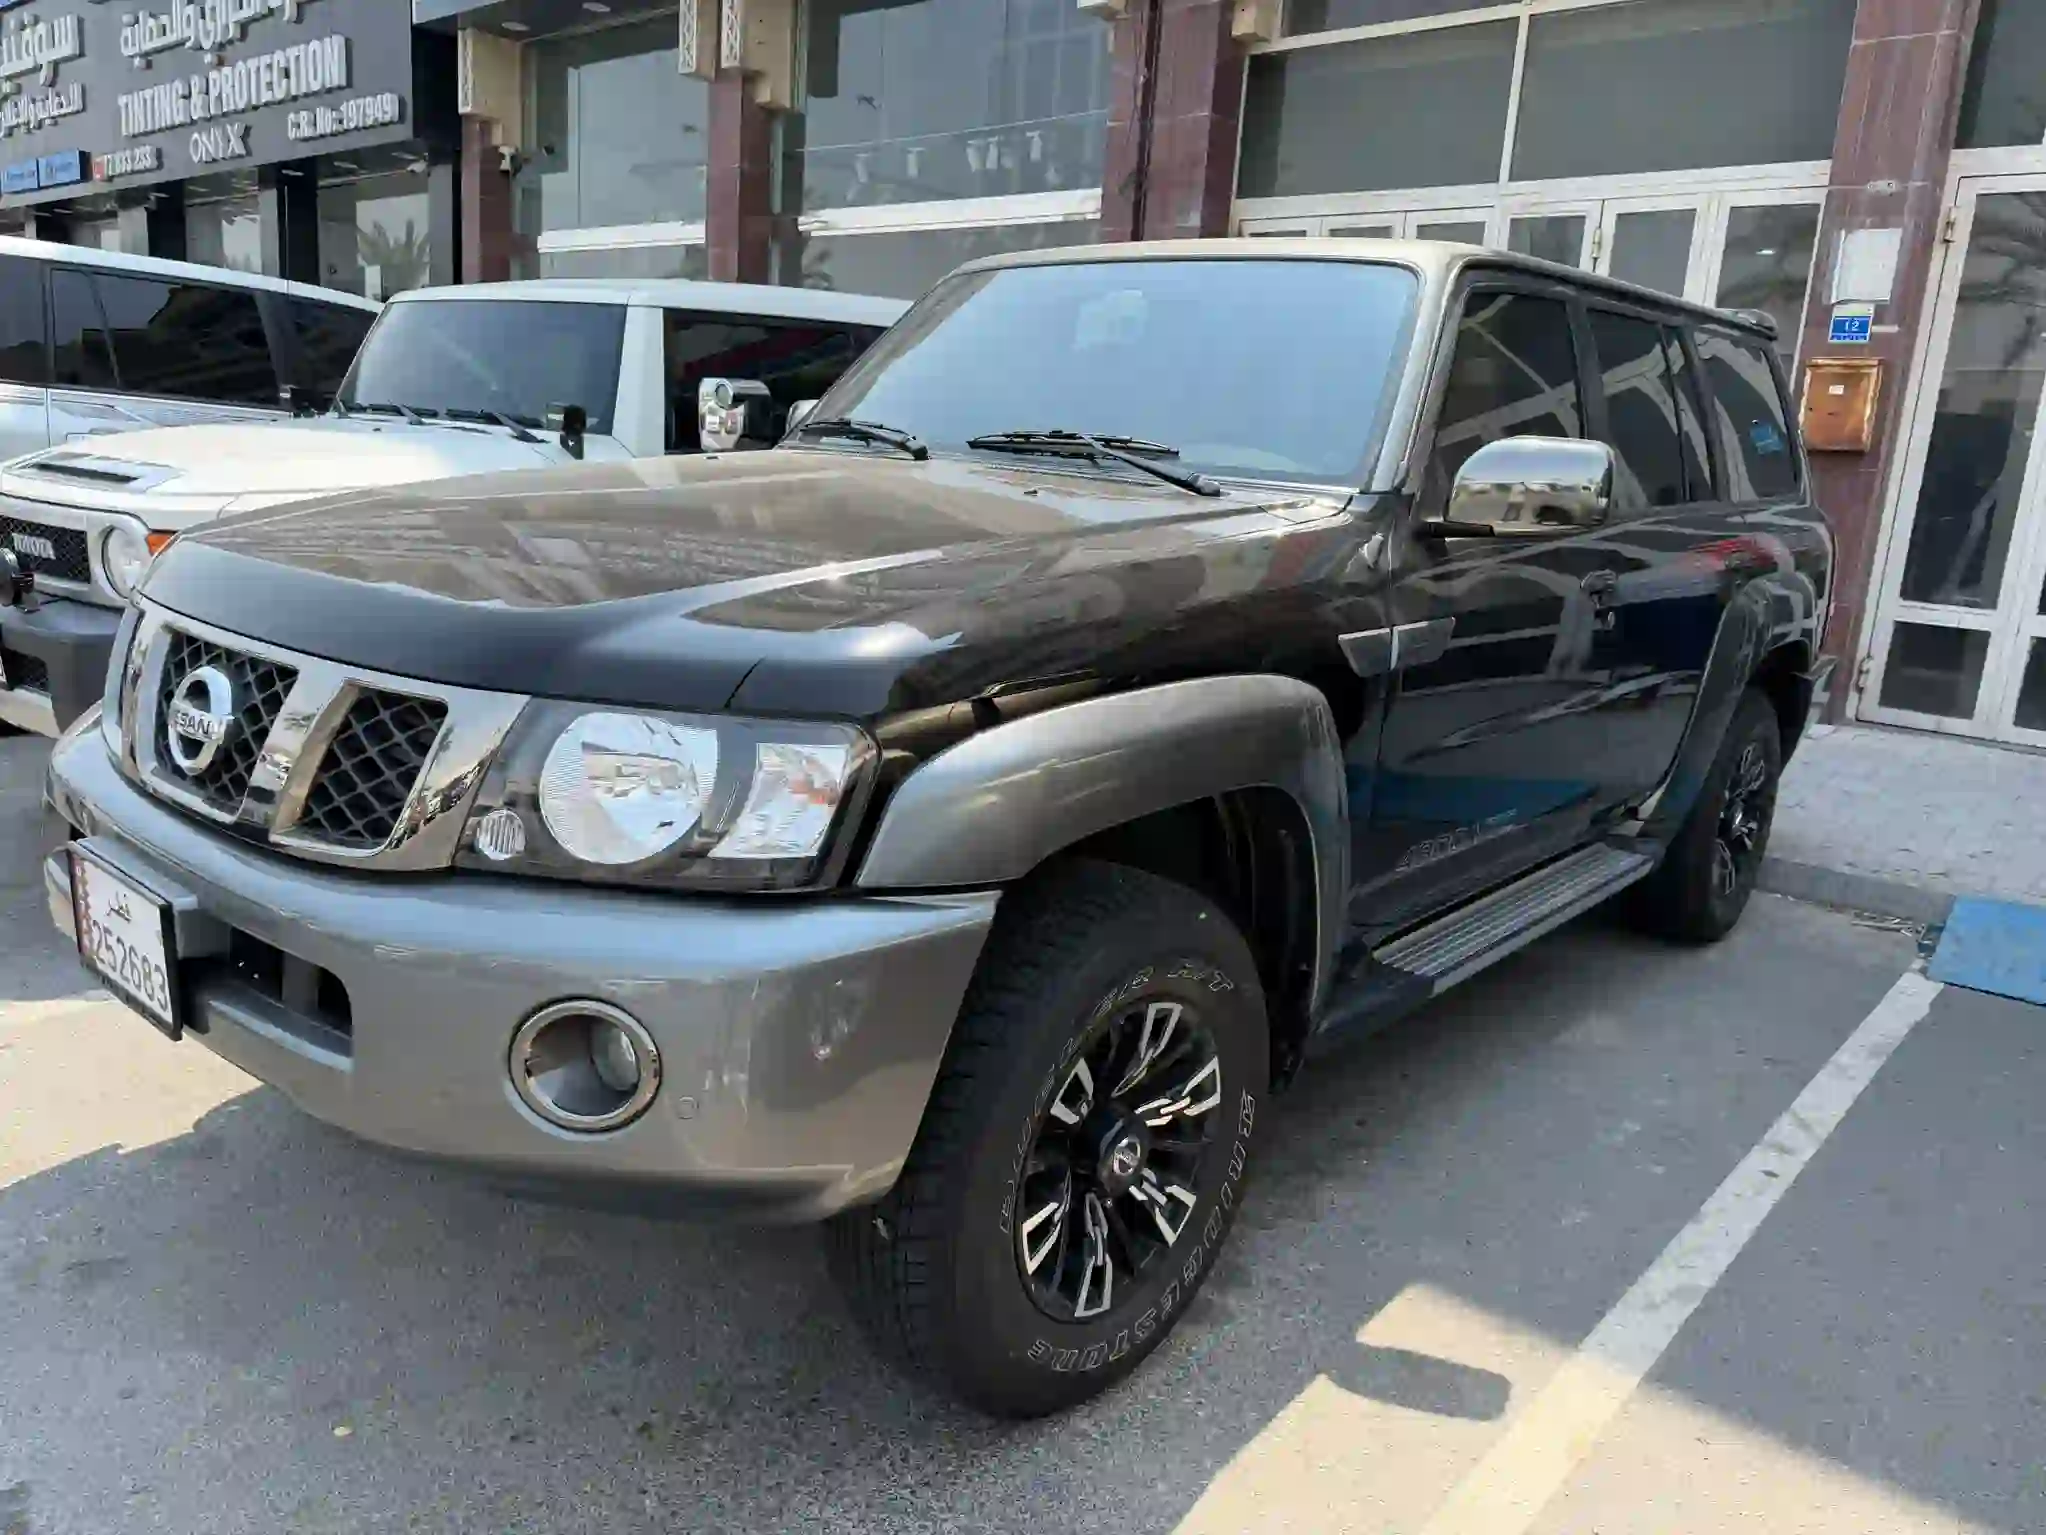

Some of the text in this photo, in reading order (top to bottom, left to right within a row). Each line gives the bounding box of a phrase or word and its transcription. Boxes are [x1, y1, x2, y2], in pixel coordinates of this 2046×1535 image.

[118, 34, 343, 137] TINTING & PROTECTION
[190, 122, 246, 163] ONYX
[1845, 319, 1860, 331] 12
[12, 532, 56, 560] TOYOTA
[106, 890, 132, 924] قطر
[92, 919, 168, 1012] 252683
